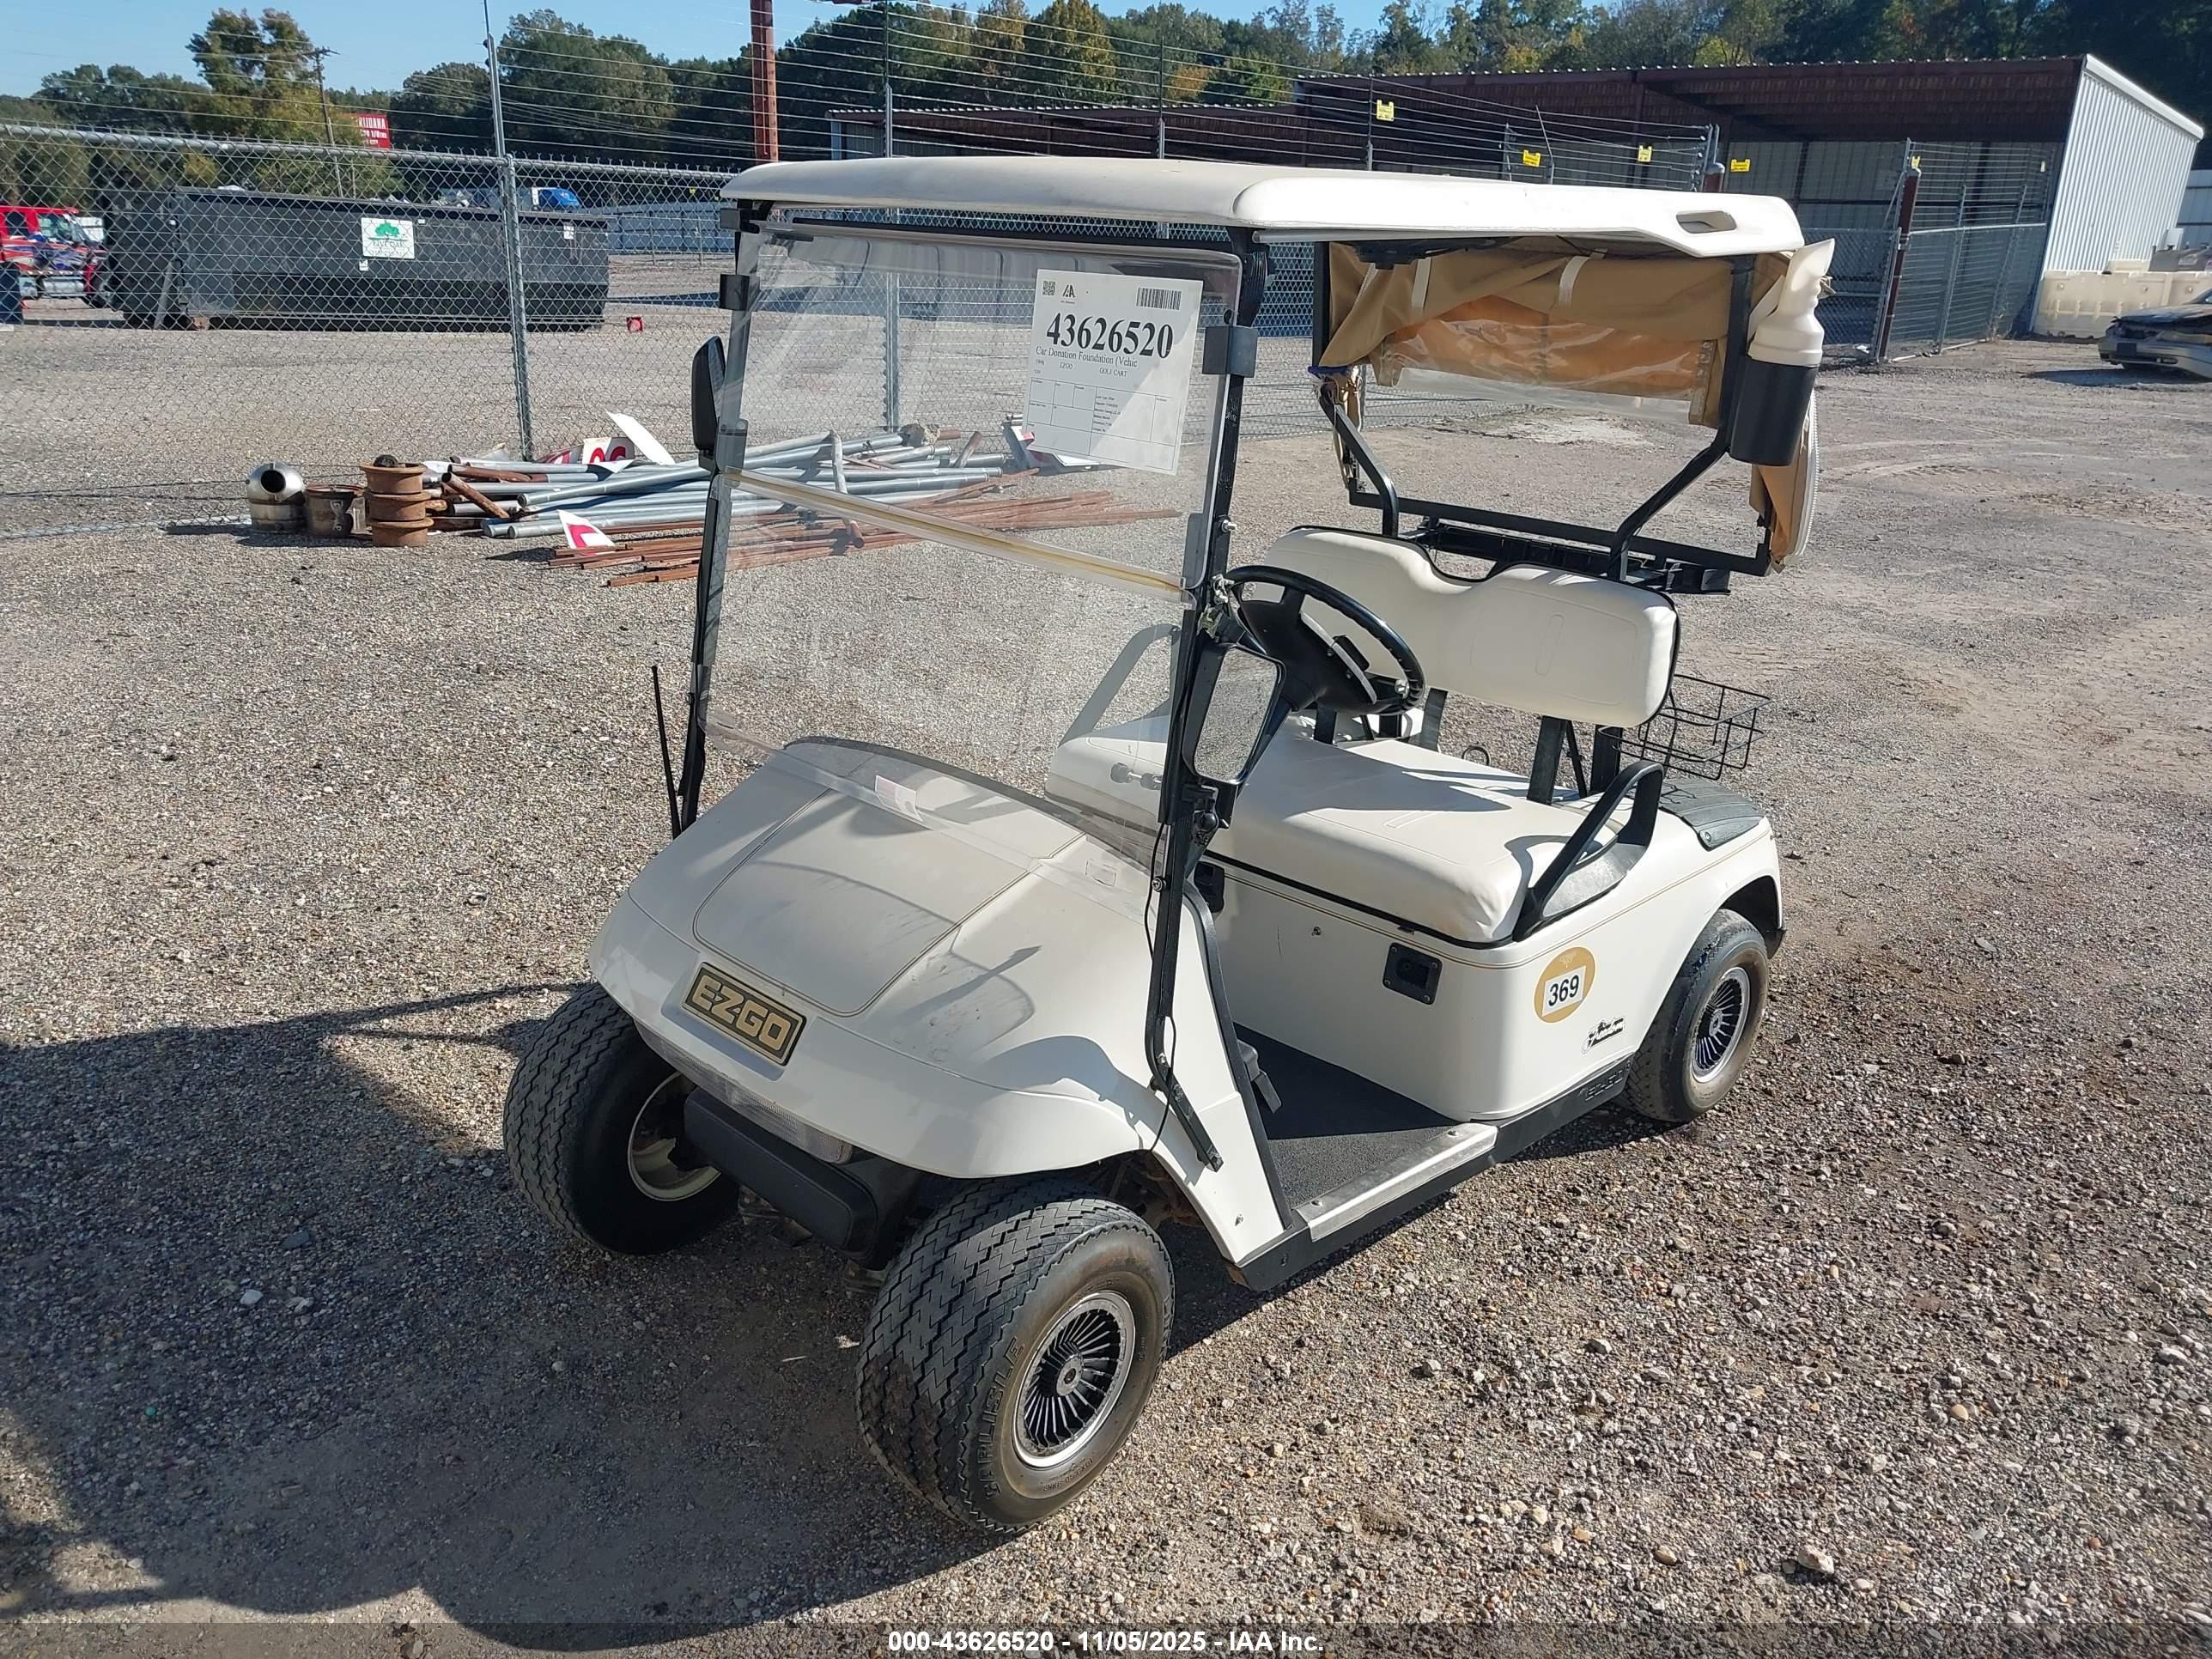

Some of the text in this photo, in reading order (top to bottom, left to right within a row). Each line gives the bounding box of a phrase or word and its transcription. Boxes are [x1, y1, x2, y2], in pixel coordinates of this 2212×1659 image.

[1046, 312, 1174, 359] 43626520
[1036, 345, 1138, 368] Car Donation Foundation (Vehic
[1113, 368, 1127, 378] CART
[1548, 975, 1580, 1007] 369
[976, 1336, 1025, 1500] CARLISLE
